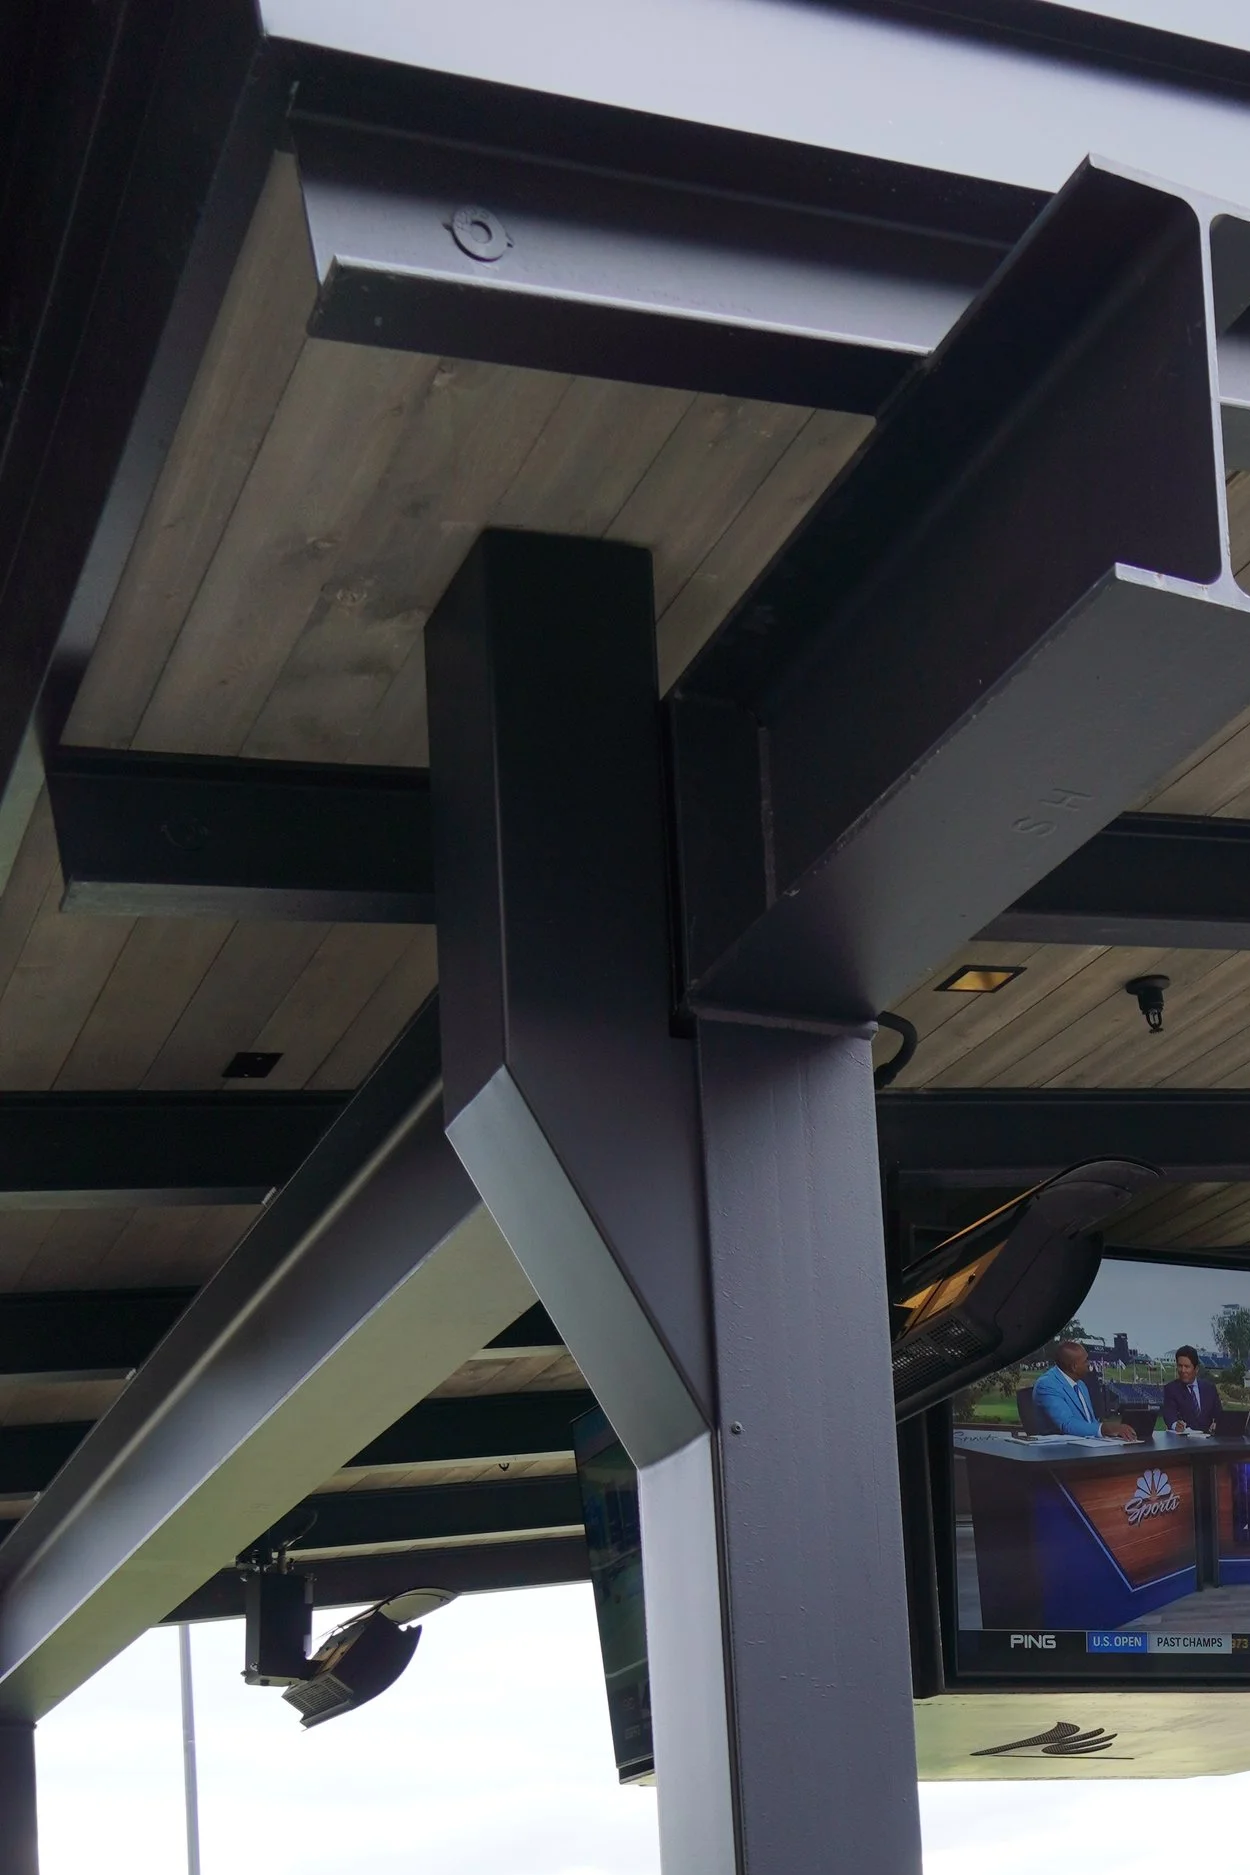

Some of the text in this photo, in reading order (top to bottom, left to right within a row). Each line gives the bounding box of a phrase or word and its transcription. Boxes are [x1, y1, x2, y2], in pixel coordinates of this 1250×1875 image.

[1125, 1493, 1180, 1523] Sports
[1010, 1634, 1057, 1649] PING
[1093, 1636, 1142, 1647] U.S. OPEN
[1157, 1637, 1223, 1648] PAST CHAMPS
